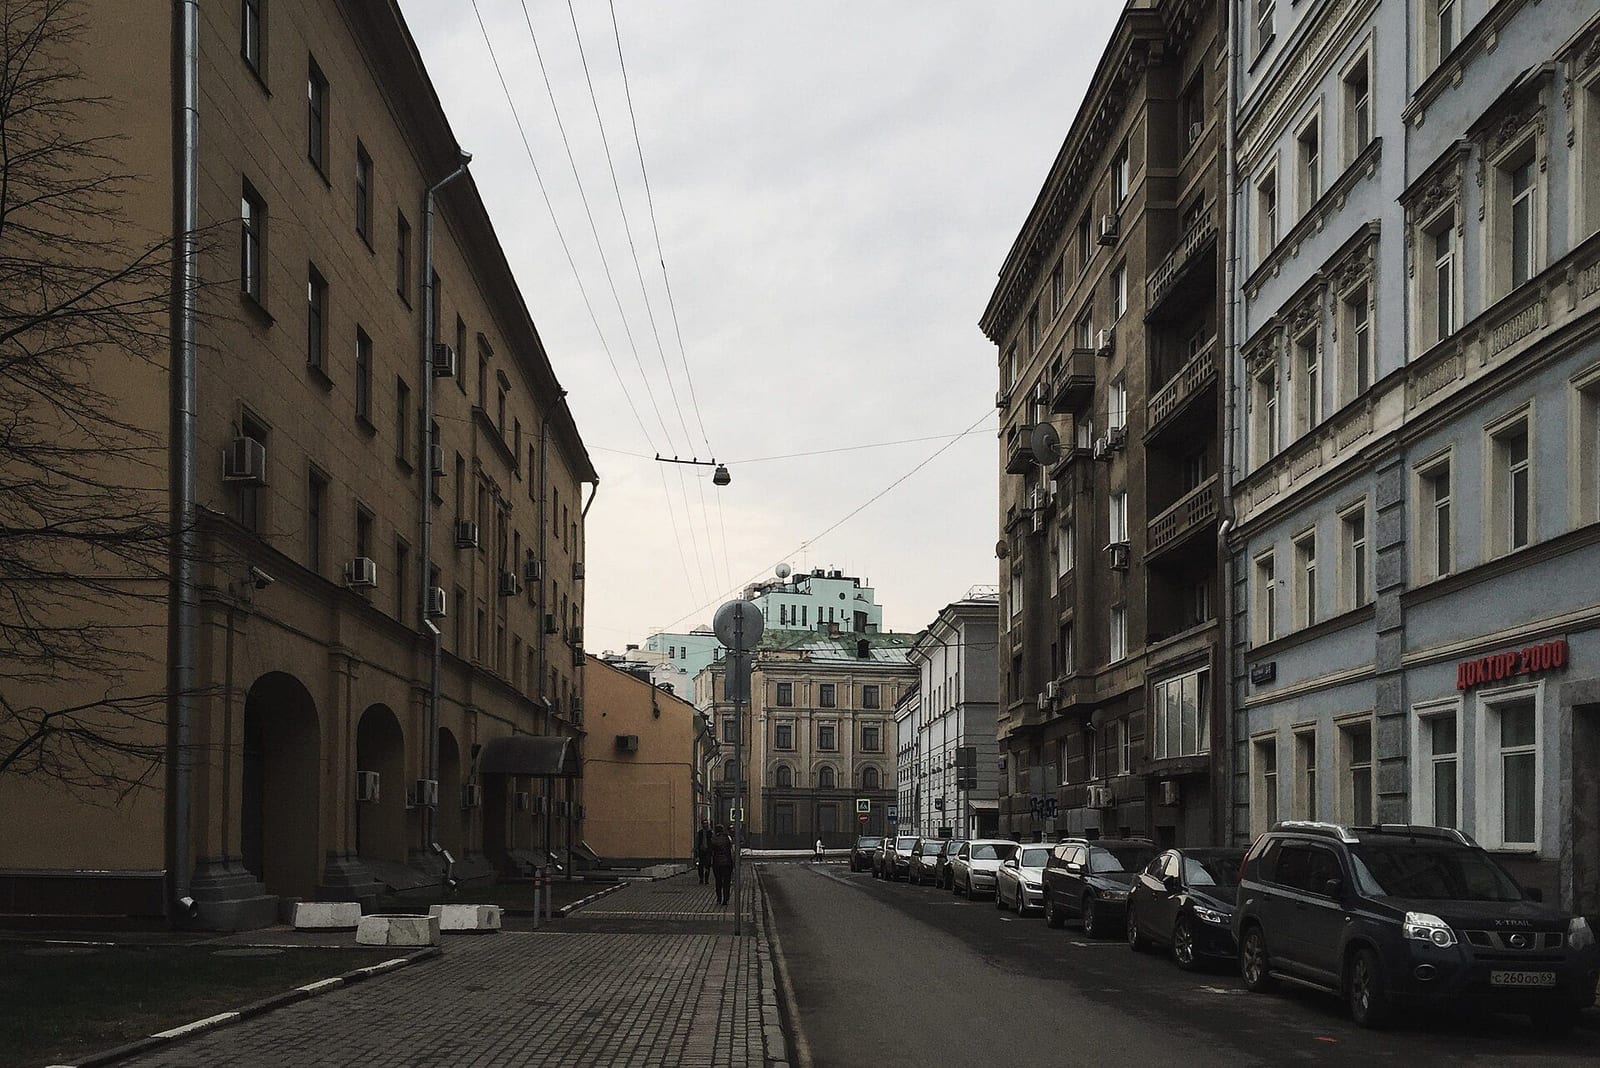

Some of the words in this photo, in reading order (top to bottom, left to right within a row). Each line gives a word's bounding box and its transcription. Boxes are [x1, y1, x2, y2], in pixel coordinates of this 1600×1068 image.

[1456, 651, 1516, 690] ДОКТОР
[1521, 639, 1566, 674] 2000
[1495, 919, 1531, 927] X-TRAIL
